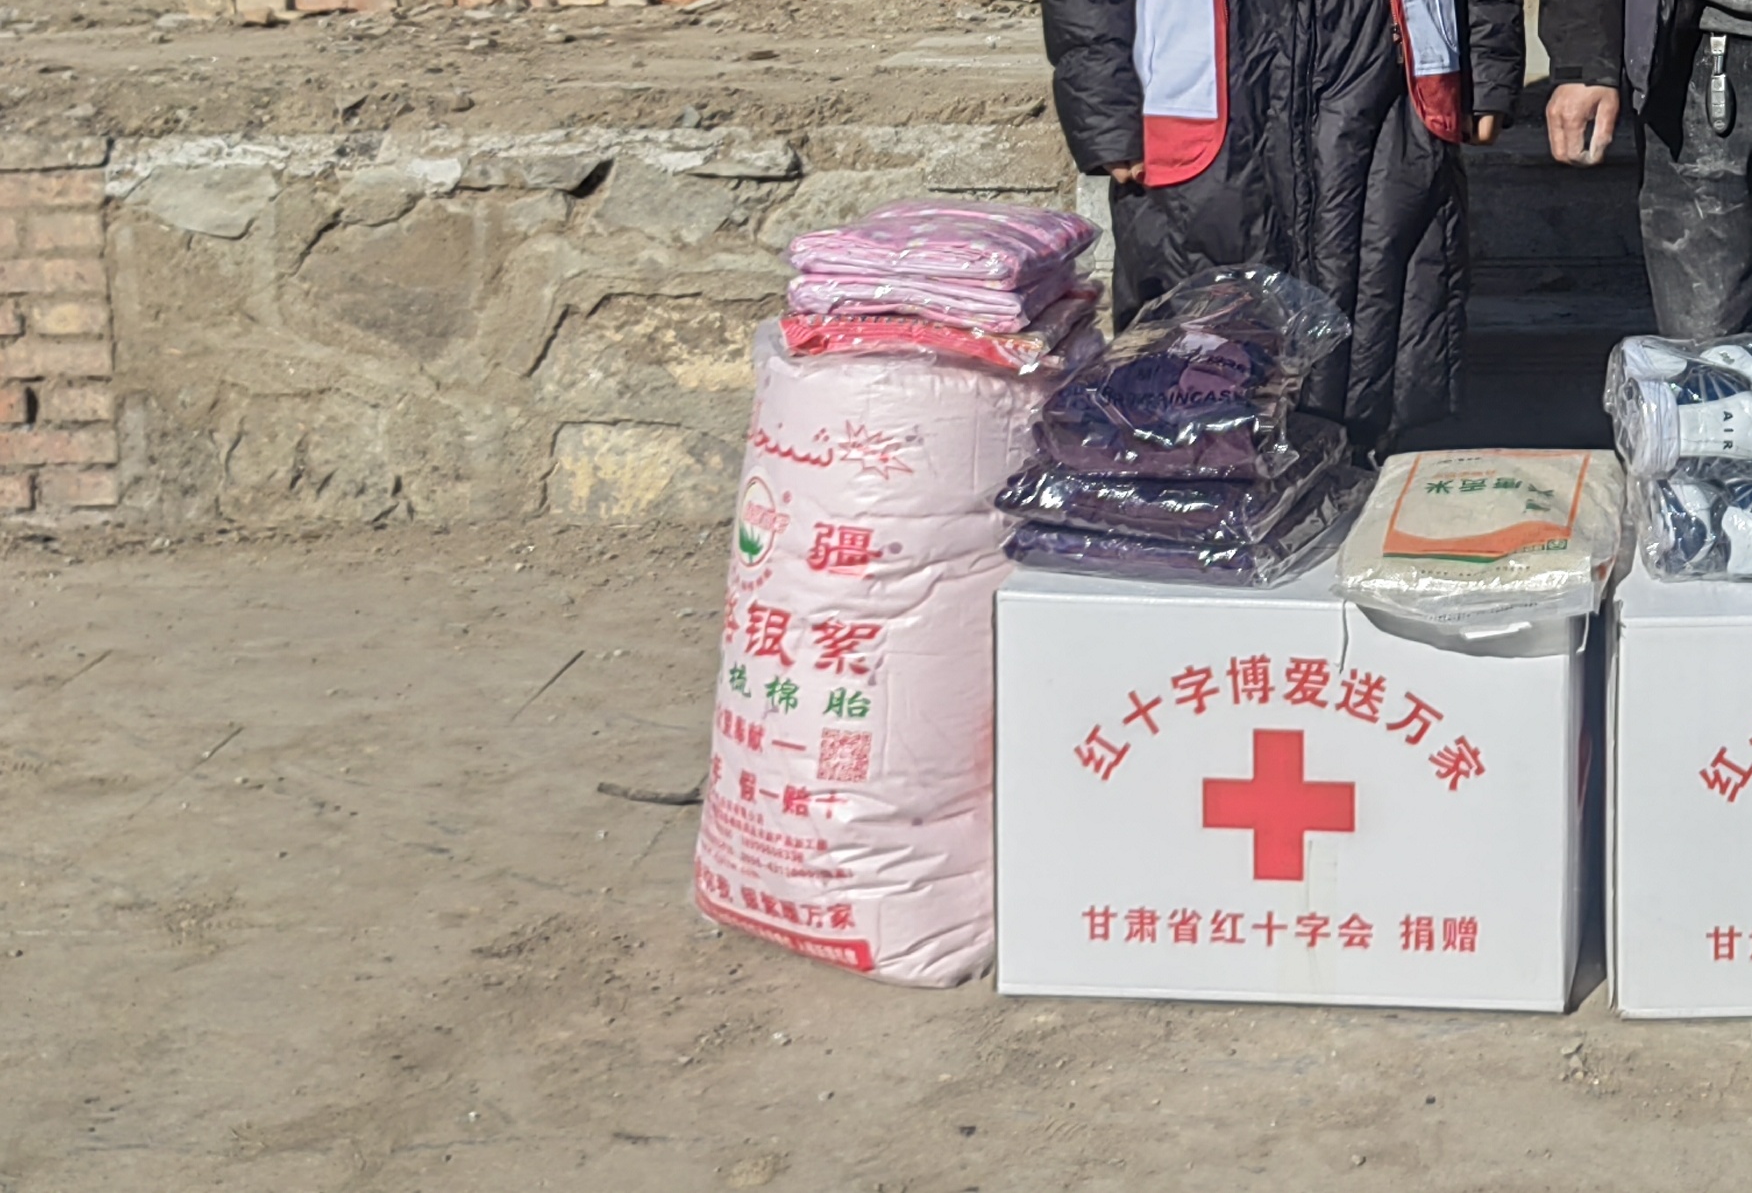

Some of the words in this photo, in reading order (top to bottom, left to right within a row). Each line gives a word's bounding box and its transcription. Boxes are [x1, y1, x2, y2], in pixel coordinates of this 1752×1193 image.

[1722, 410, 1734, 451] AIR
[806, 522, 884, 579] 疆
[1073, 653, 1487, 792] 红十字博爱送万家
[1082, 906, 1374, 950] 甘肃省红十字会
[1399, 914, 1480, 953] 捐赠
